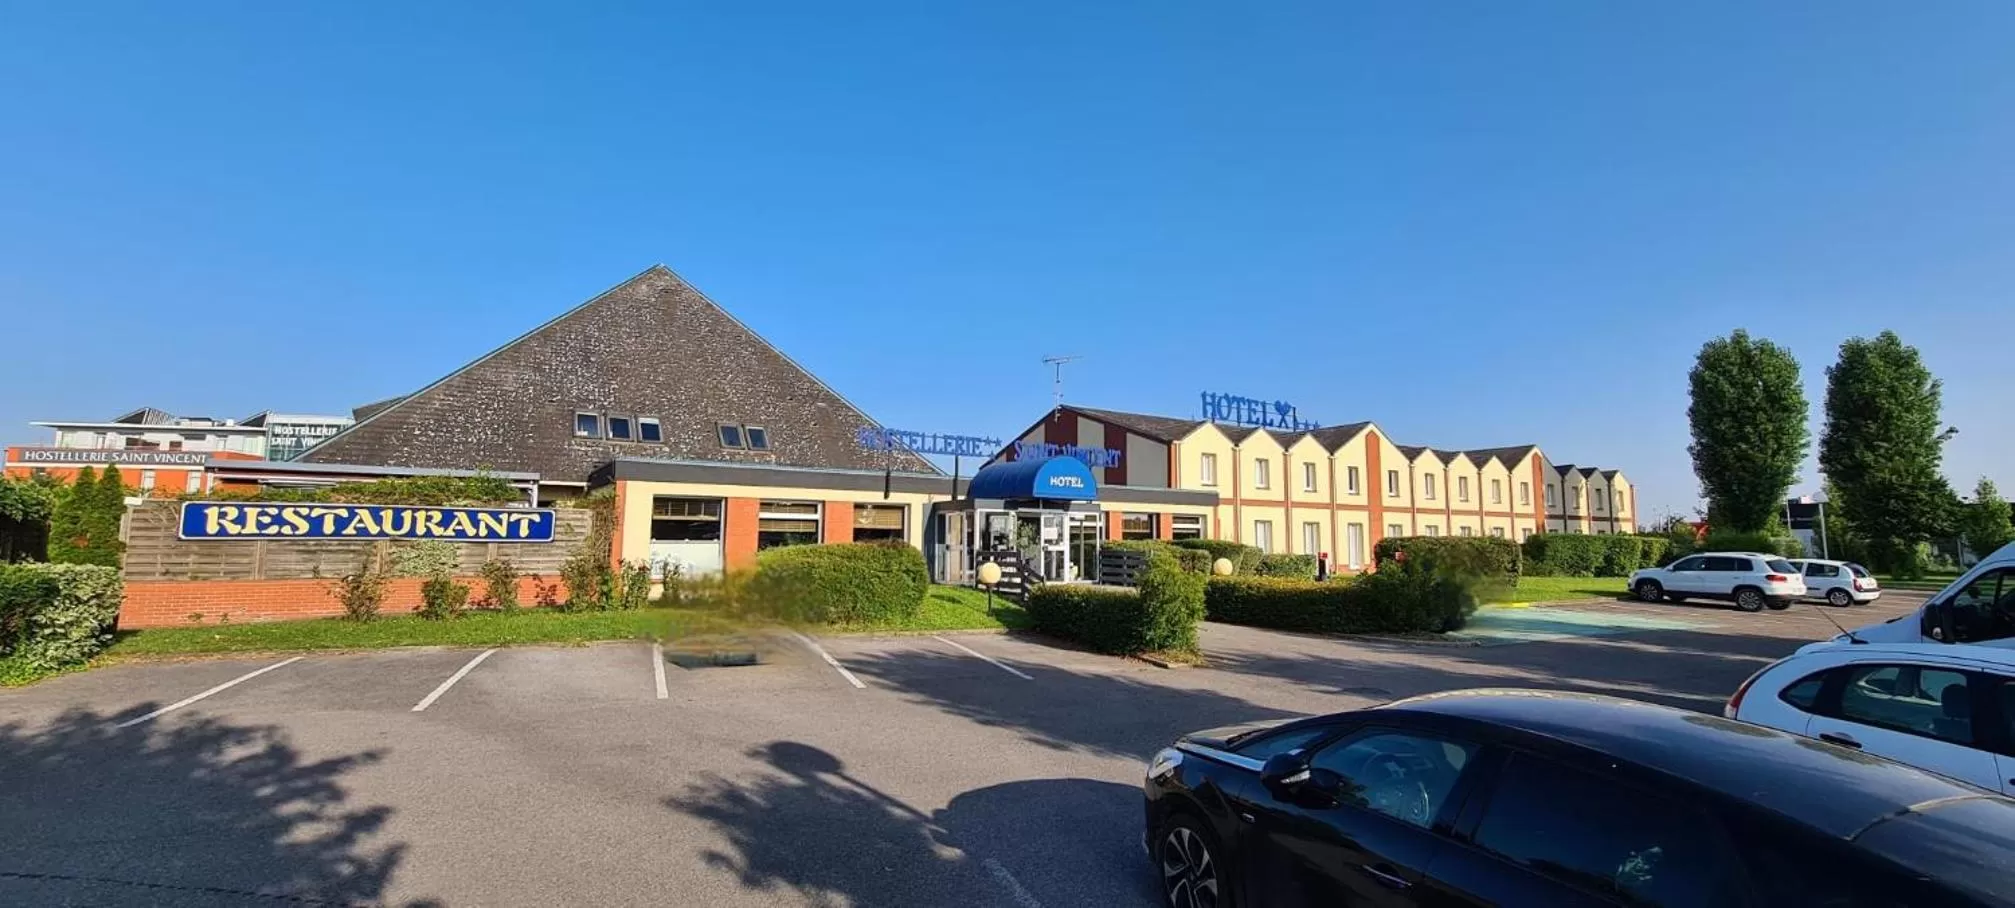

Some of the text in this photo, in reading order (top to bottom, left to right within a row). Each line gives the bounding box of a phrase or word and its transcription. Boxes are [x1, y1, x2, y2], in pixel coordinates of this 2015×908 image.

[1201, 390, 1274, 426] HOTEL
[274, 425, 338, 435] HOSTELLERIE
[271, 437, 297, 447] SAINT
[858, 426, 982, 456] HOSTELLERIE
[24, 450, 207, 464] HOSTELLERIE SAINT VINCENT
[1050, 476, 1084, 488] HOTEL
[203, 505, 541, 538] RESTAURANT
